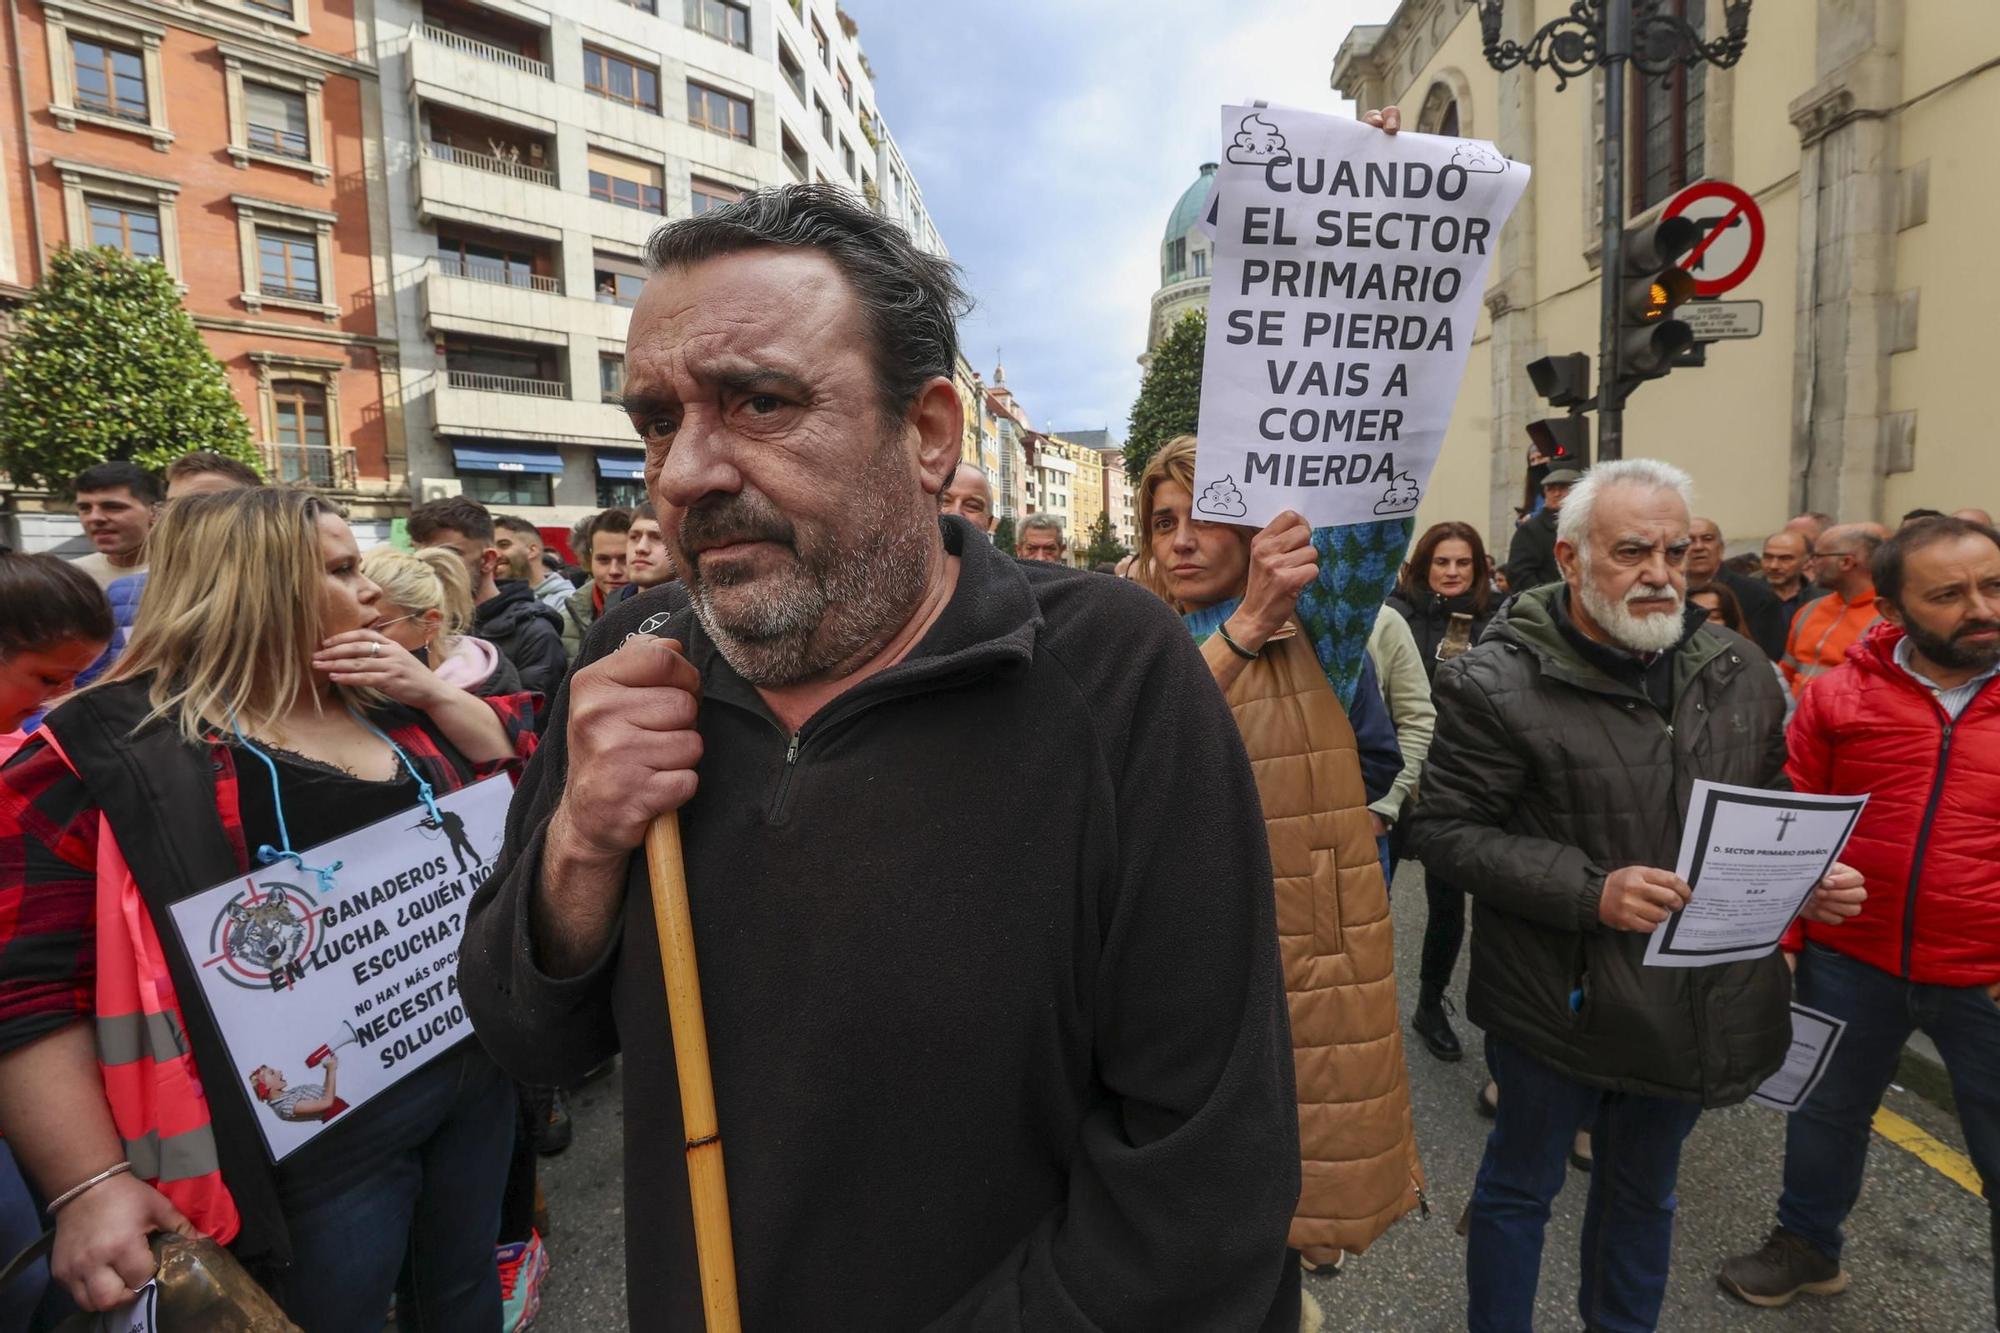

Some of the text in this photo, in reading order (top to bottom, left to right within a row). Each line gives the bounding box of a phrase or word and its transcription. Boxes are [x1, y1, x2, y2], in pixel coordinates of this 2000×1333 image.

[1265, 156, 1467, 201] CUANDO
[1242, 207, 1490, 255] EL SECTOR
[1241, 259, 1461, 303] PRIMARIO
[1226, 309, 1454, 351] SE PIERDA
[1267, 360, 1409, 397] VAIS A
[1258, 408, 1404, 443] COMER
[1244, 451, 1395, 488] MIERDA
[1725, 847, 1755, 855] SECTOR
[1797, 848, 1828, 856] ESPAÑOL
[323, 856, 448, 928] GANADEROS
[268, 959, 305, 992] EN
[310, 919, 390, 971] LUCHA
[397, 879, 466, 928] ¿QUIÉN
[352, 913, 462, 986] ESCUCHA?
[354, 949, 461, 1017] NO HAY MÁS OPCI
[380, 1005, 470, 1069] SOLUCIO
